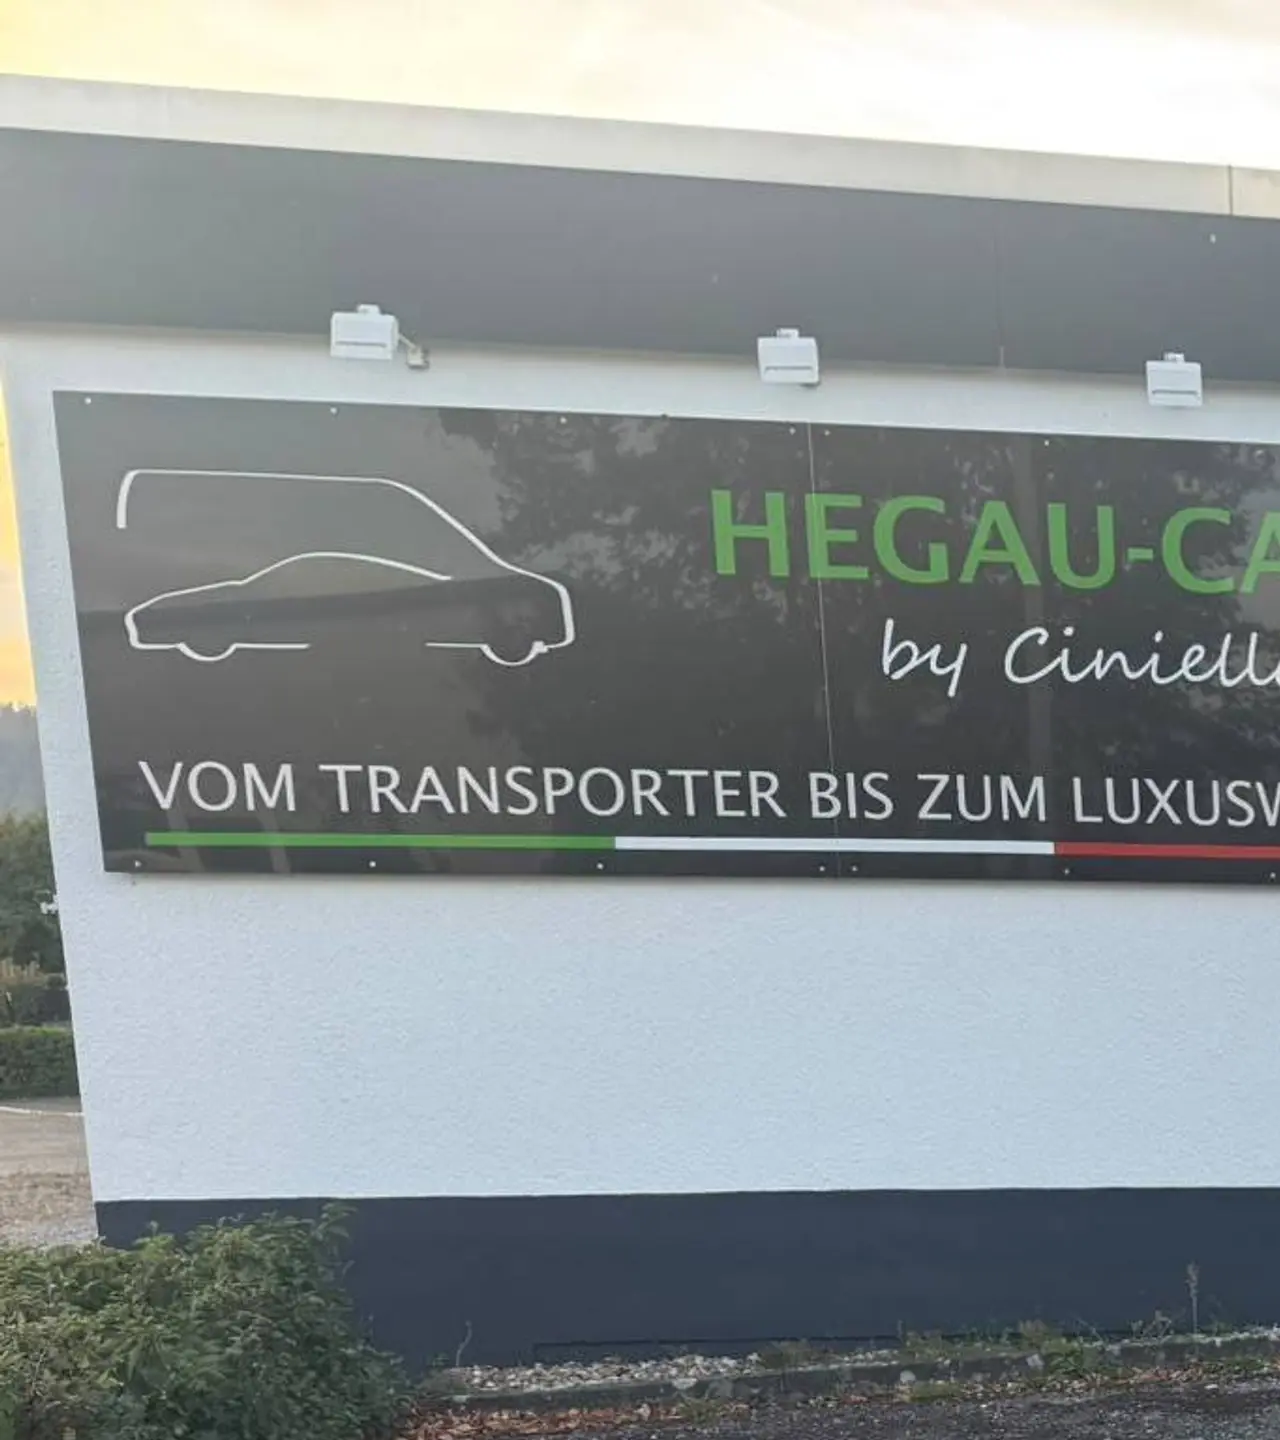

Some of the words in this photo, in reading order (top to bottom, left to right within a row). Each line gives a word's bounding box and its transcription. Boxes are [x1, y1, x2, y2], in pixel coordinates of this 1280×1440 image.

[880, 619, 968, 697] by
[138, 761, 297, 812] VOM
[319, 764, 787, 818] TRANSPORTER
[808, 771, 894, 821] BIS
[917, 773, 1047, 823] ZUM
